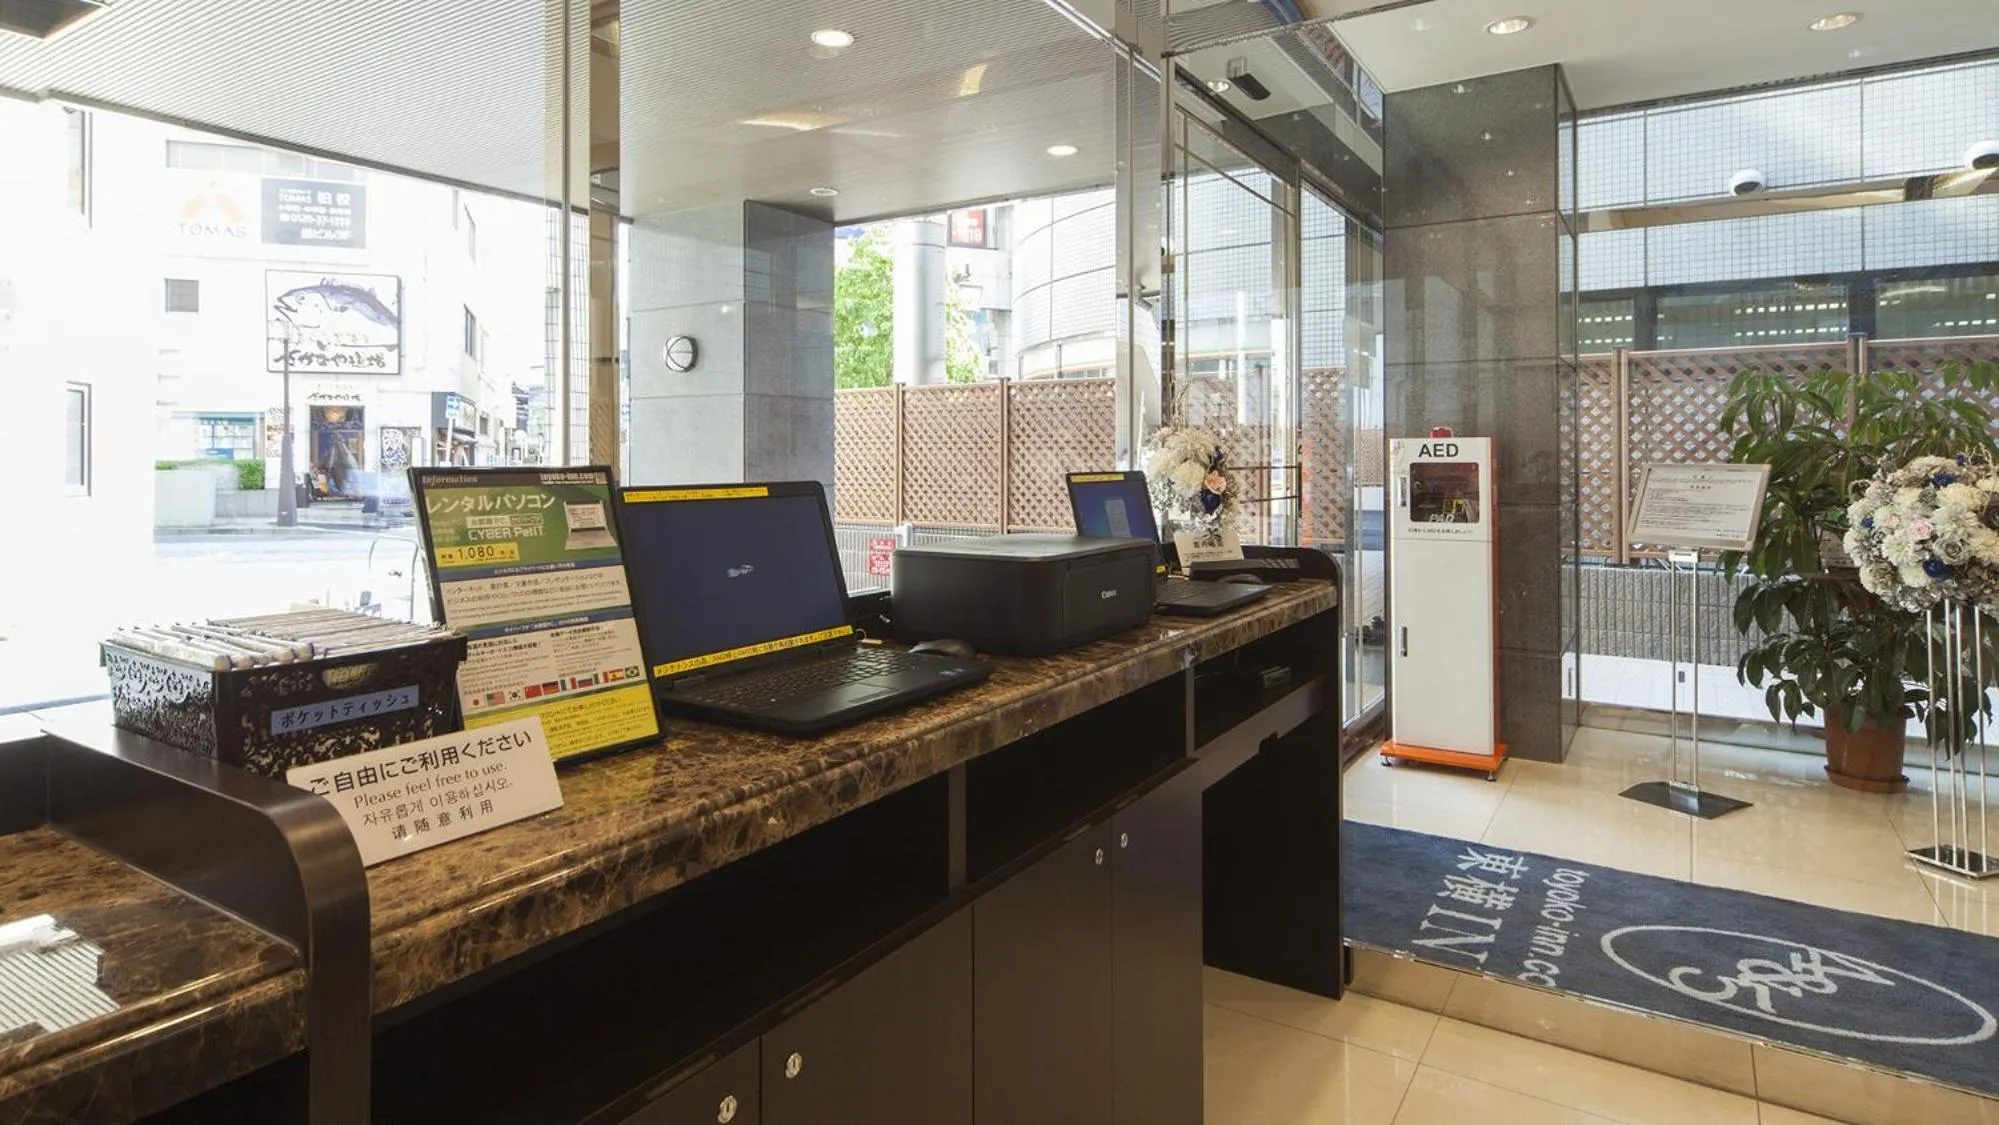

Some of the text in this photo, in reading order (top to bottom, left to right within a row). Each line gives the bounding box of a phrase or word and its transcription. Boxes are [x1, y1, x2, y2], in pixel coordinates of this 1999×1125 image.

[178, 222, 247, 239] TOMAS
[1418, 443, 1459, 458] AED
[425, 494, 556, 514] レンタルパソコン
[468, 527, 513, 541] CYBER
[281, 694, 409, 728] ポケットティッシュ
[310, 731, 532, 796] ご自由にご利用ください
[354, 762, 508, 809] Please feel free to use.
[363, 802, 424, 827] 자유롭게
